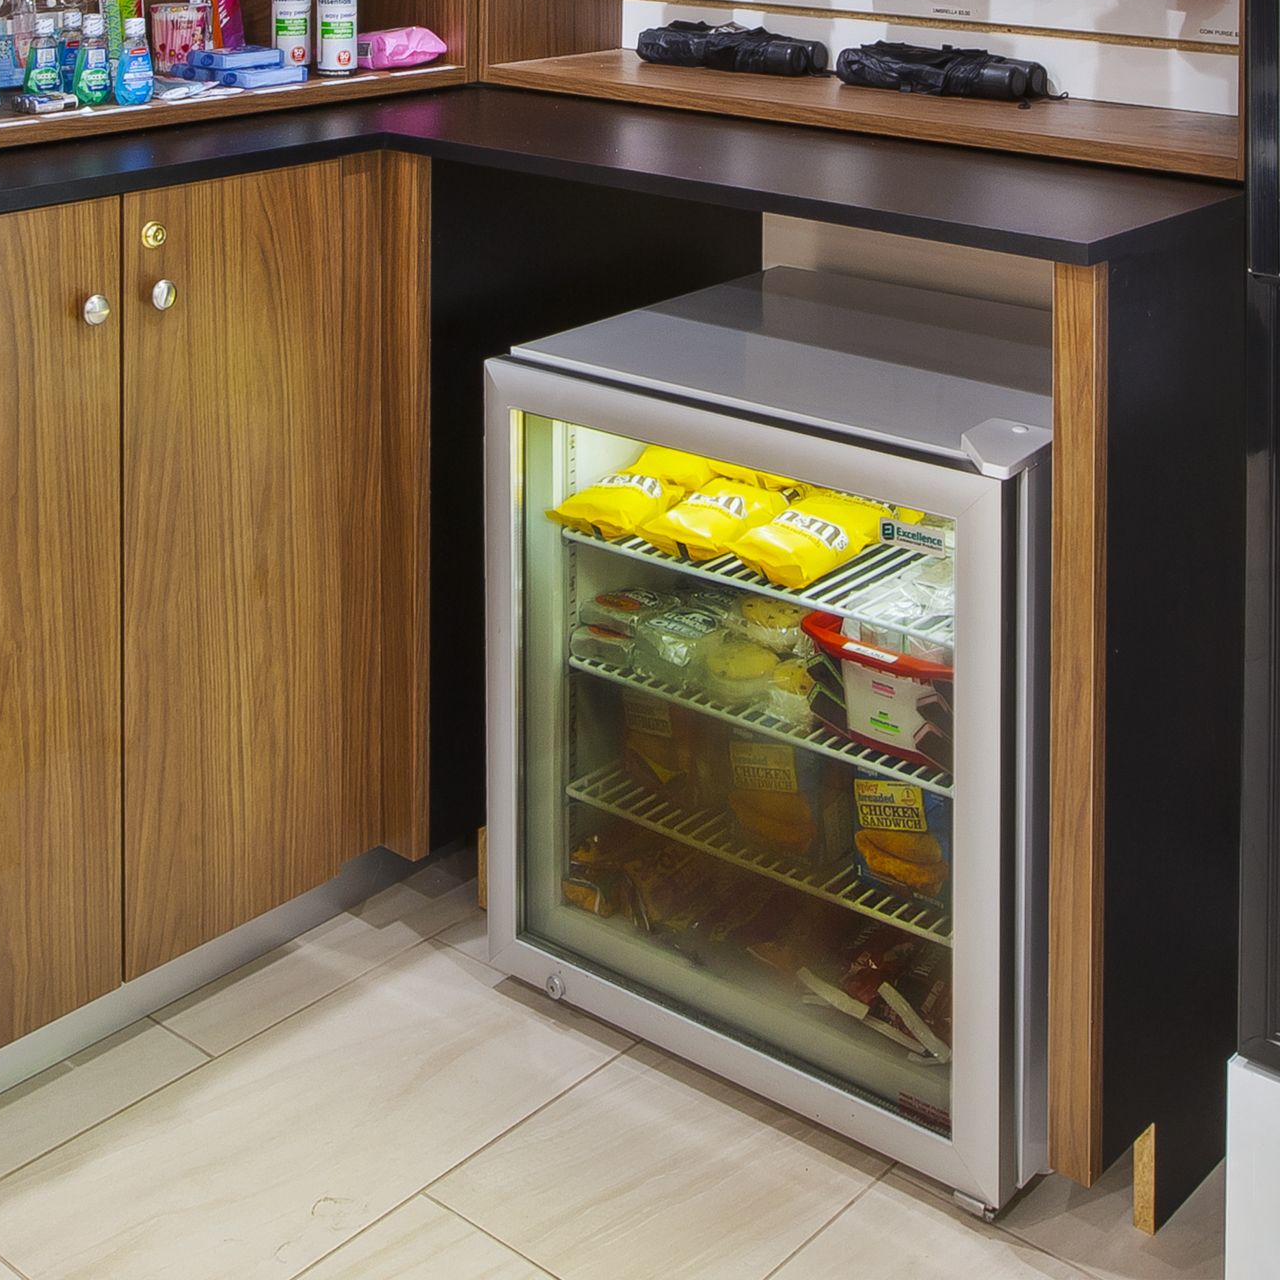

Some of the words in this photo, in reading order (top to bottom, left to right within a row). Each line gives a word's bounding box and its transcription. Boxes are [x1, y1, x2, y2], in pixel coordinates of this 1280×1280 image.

[897, 527, 942, 546] Excellence
[860, 805, 919, 818] CHICKEN
[862, 817, 922, 829] SANDWICH
